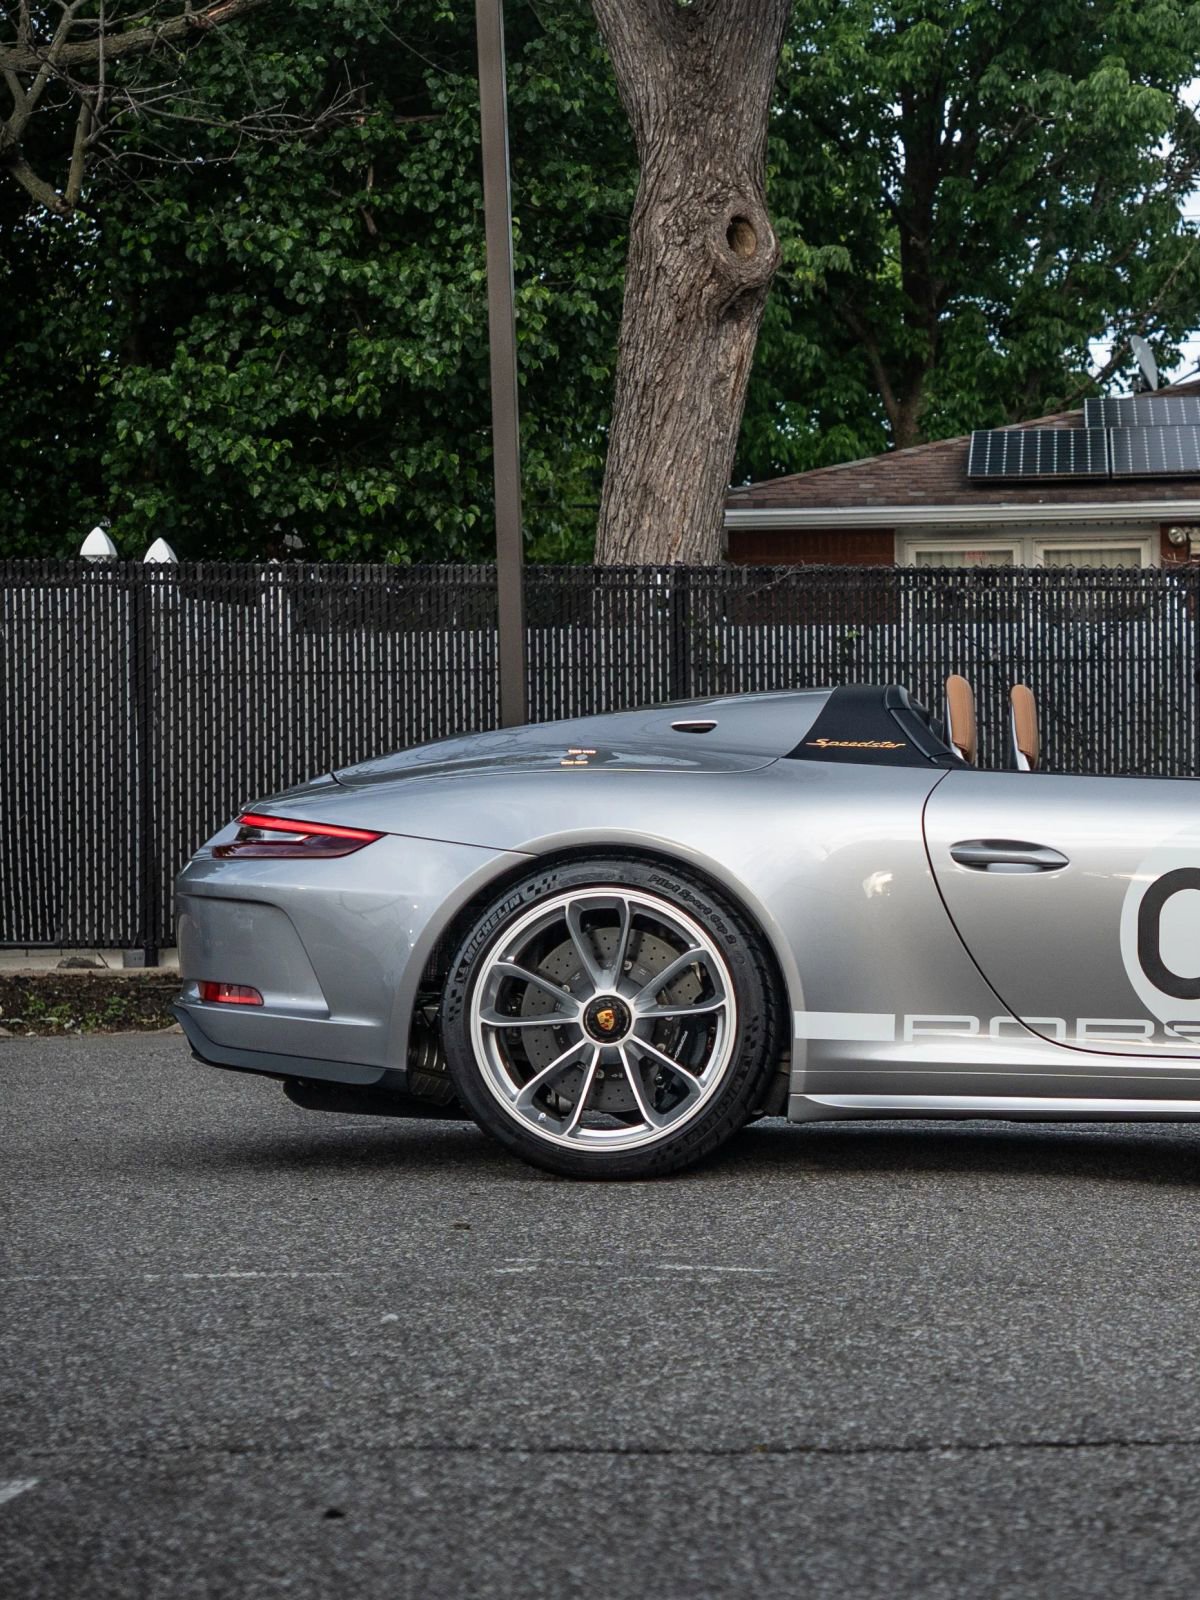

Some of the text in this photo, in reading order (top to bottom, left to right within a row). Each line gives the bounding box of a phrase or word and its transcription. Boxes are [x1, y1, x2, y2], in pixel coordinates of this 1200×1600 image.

[806, 738, 906, 748] Speedster
[463, 893, 522, 964] MICHELIN
[648, 874, 681, 893] Pilot
[678, 888, 713, 916] Sport
[710, 914, 729, 935] Cup
[725, 934, 737, 945] 2
